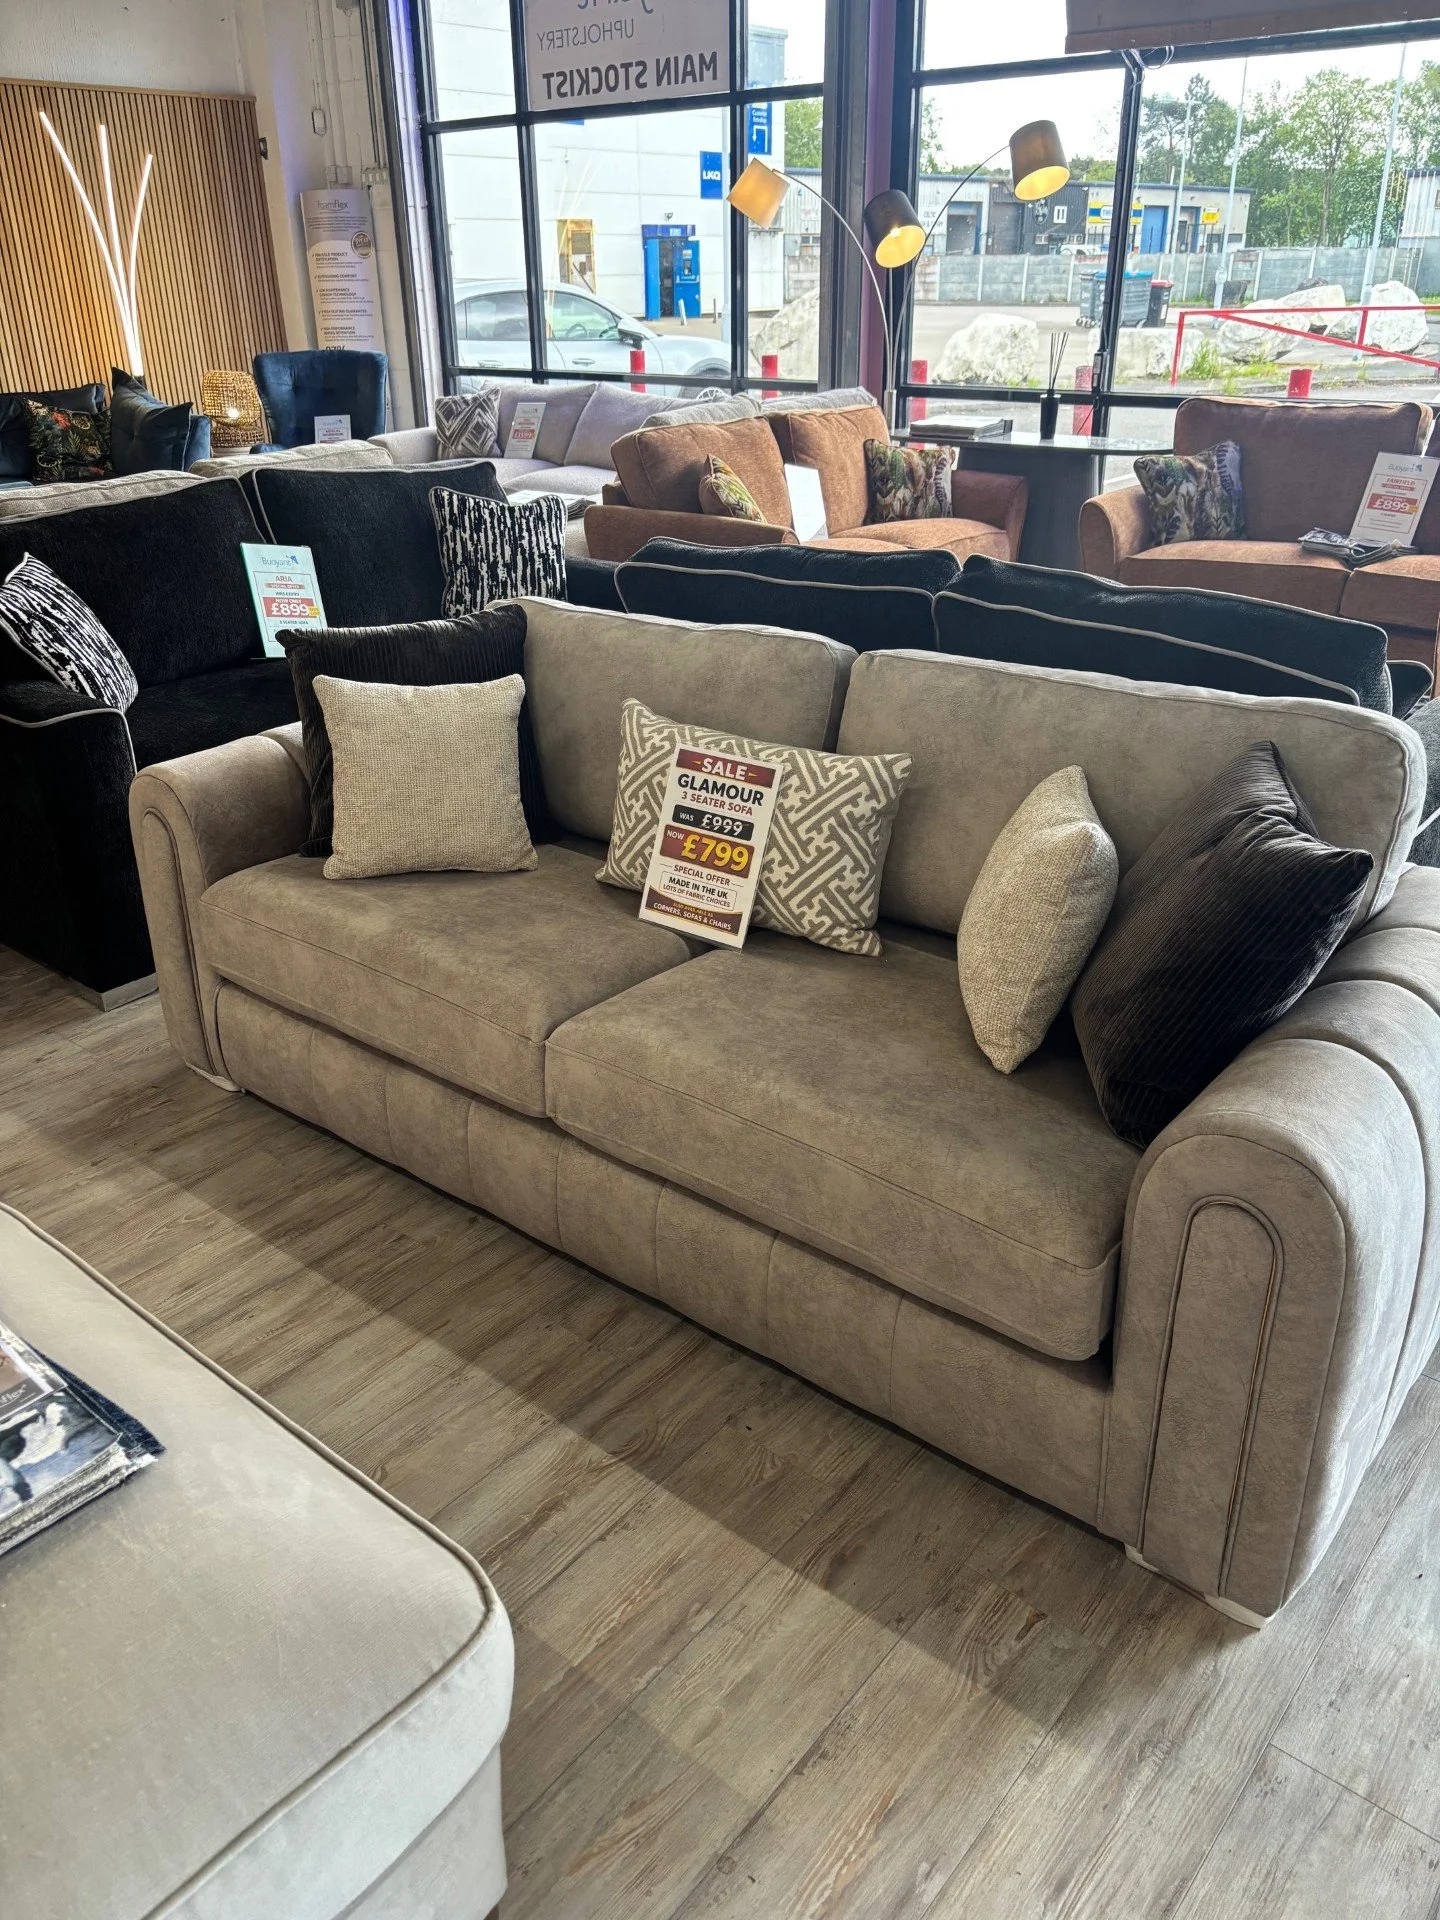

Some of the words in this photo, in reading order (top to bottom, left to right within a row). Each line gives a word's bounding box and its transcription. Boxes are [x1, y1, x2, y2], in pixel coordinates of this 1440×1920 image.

[703, 170, 721, 182] LKQ
[1386, 477, 1416, 486] FAIRFIELD
[1373, 498, 1409, 512] £899
[261, 556, 291, 567] Buoyant
[271, 603, 308, 616] £899
[701, 758, 748, 780] SALE
[677, 773, 764, 807] GLAMOUR
[681, 791, 688, 800] 3
[690, 793, 726, 809] SEATER
[727, 802, 753, 816] SOFA
[679, 812, 694, 822] WAS
[701, 814, 743, 836] £999
[667, 830, 685, 840] NOW
[681, 834, 749, 871] £799
[674, 864, 704, 879] SPECIAL
[706, 873, 731, 886] OFFER
[663, 883, 677, 892] LOTS
[686, 890, 705, 900] FABRIC
[706, 896, 731, 908] CHOICES
[668, 876, 691, 889] MADE
[691, 883, 700, 891] IN
[702, 885, 716, 896] THE
[717, 890, 729, 899] UK
[653, 902, 682, 916] CORNERS,
[683, 911, 702, 922] SOFAS
[708, 919, 732, 931] CHAIRS
